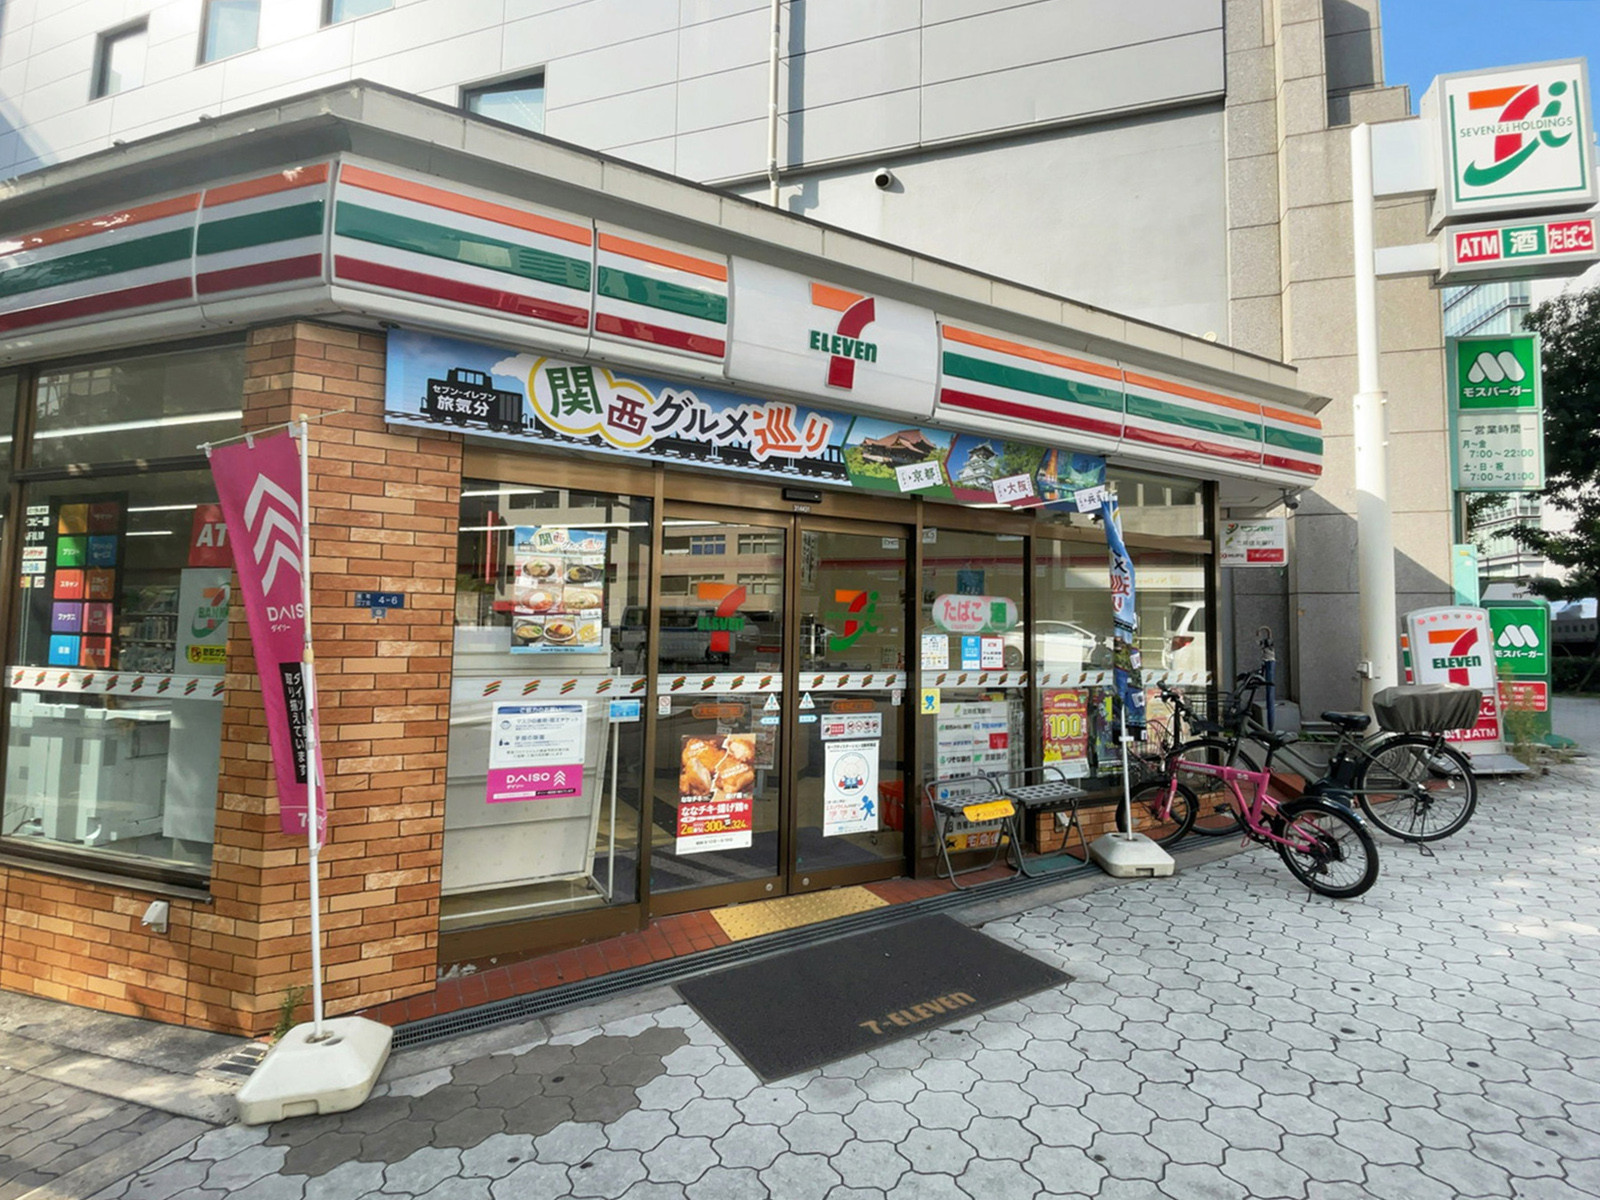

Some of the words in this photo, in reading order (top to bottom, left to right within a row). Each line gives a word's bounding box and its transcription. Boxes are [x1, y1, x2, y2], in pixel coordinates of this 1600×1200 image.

[1513, 116, 1574, 133] HOLDINGS
[1459, 234, 1499, 258] ATM
[1509, 229, 1539, 253] 酒
[1550, 225, 1593, 250] たばこ
[809, 330, 878, 363] ELEVEN
[1463, 385, 1532, 398] モスバーガー
[436, 394, 491, 418] 旅気分
[1474, 424, 1521, 434] 営業時間
[911, 467, 937, 483] 京都
[1007, 479, 1028, 495] 大阪
[196, 523, 229, 547] AT
[267, 604, 304, 622] DAIS
[943, 600, 983, 622] たばこ
[271, 624, 291, 632] ダイソー
[1432, 655, 1482, 670] ELEVEN
[1496, 650, 1544, 659] モスバーガー
[1050, 714, 1082, 740] 100
[506, 773, 551, 784] DAISO
[859, 992, 977, 1034] 7-ELEVEN
